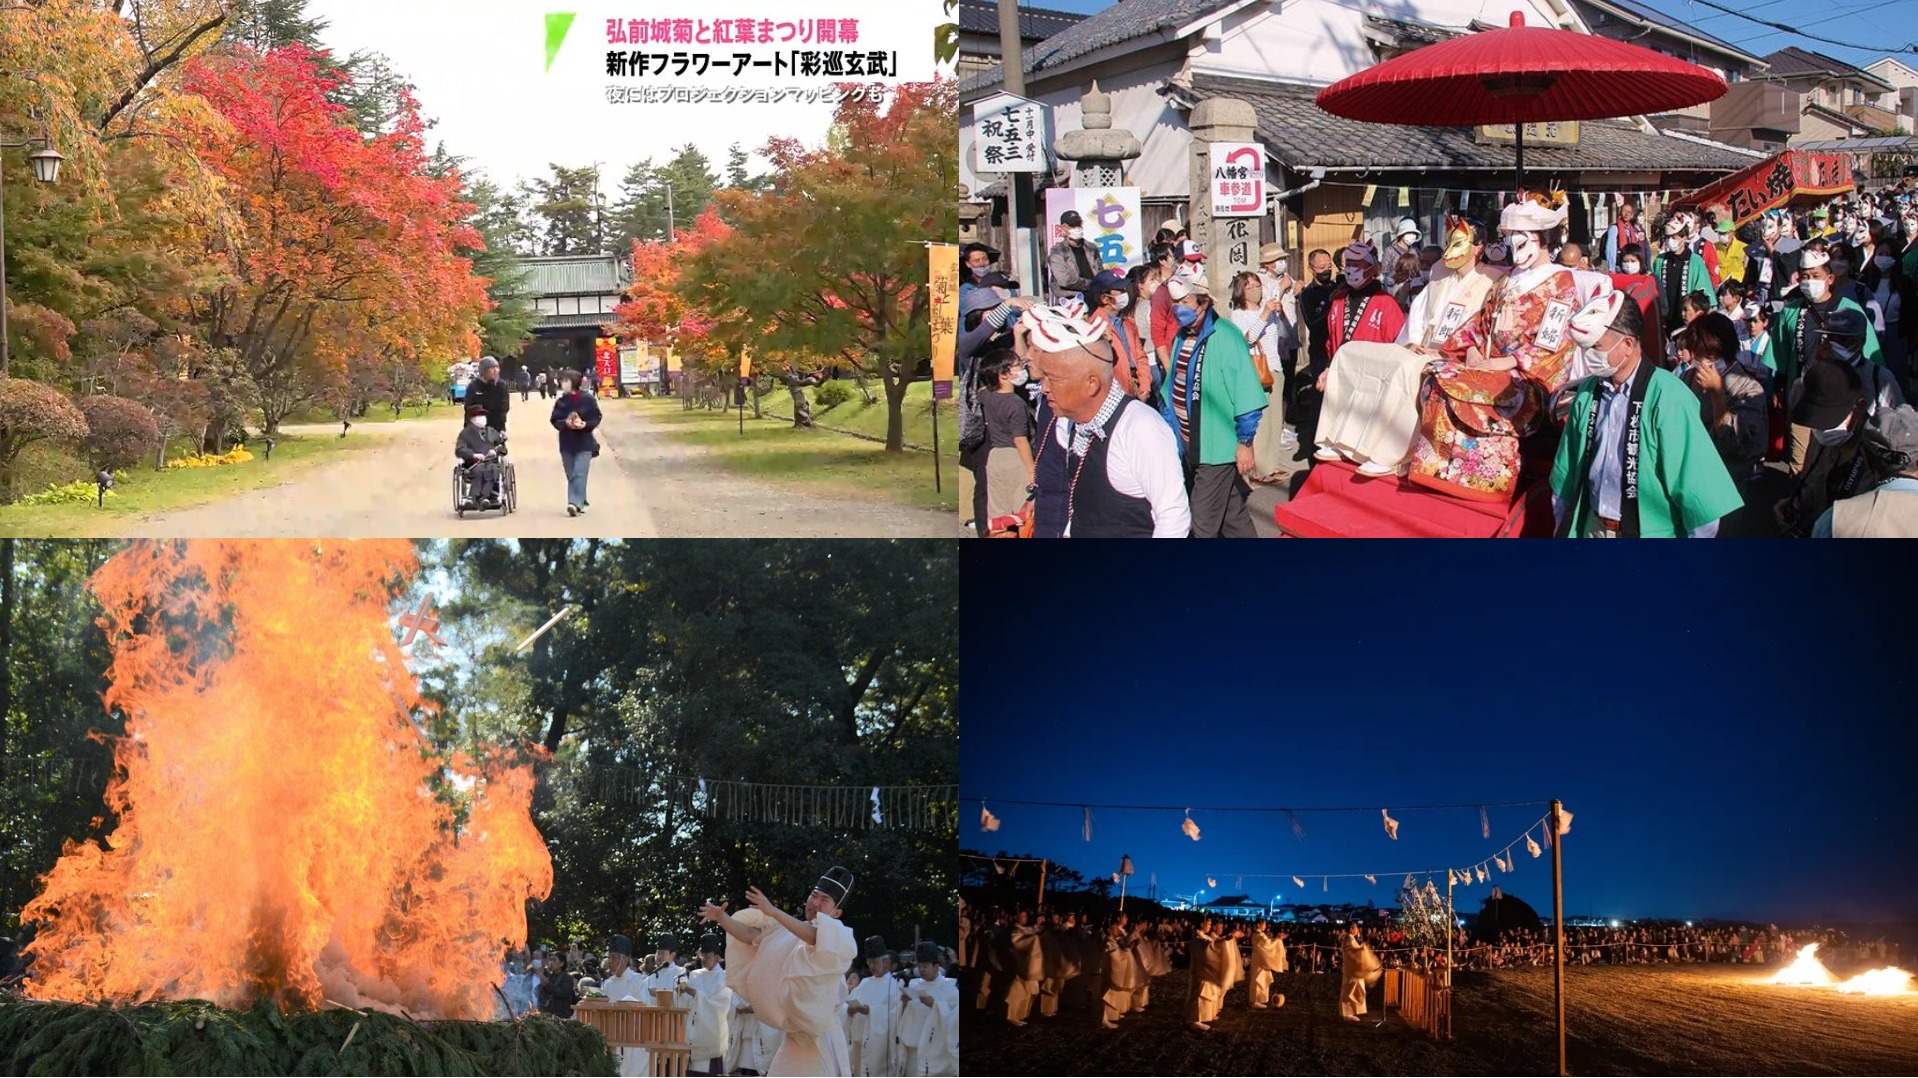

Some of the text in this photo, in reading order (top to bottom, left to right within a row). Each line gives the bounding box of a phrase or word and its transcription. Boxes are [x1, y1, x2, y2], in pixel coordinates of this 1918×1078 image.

[981, 120, 1005, 164] 祝祭
[1215, 166, 1248, 179] 八幡宮
[1219, 182, 1251, 196] 車参道
[1726, 161, 1794, 222] たい焼
[1092, 198, 1127, 276] 七五
